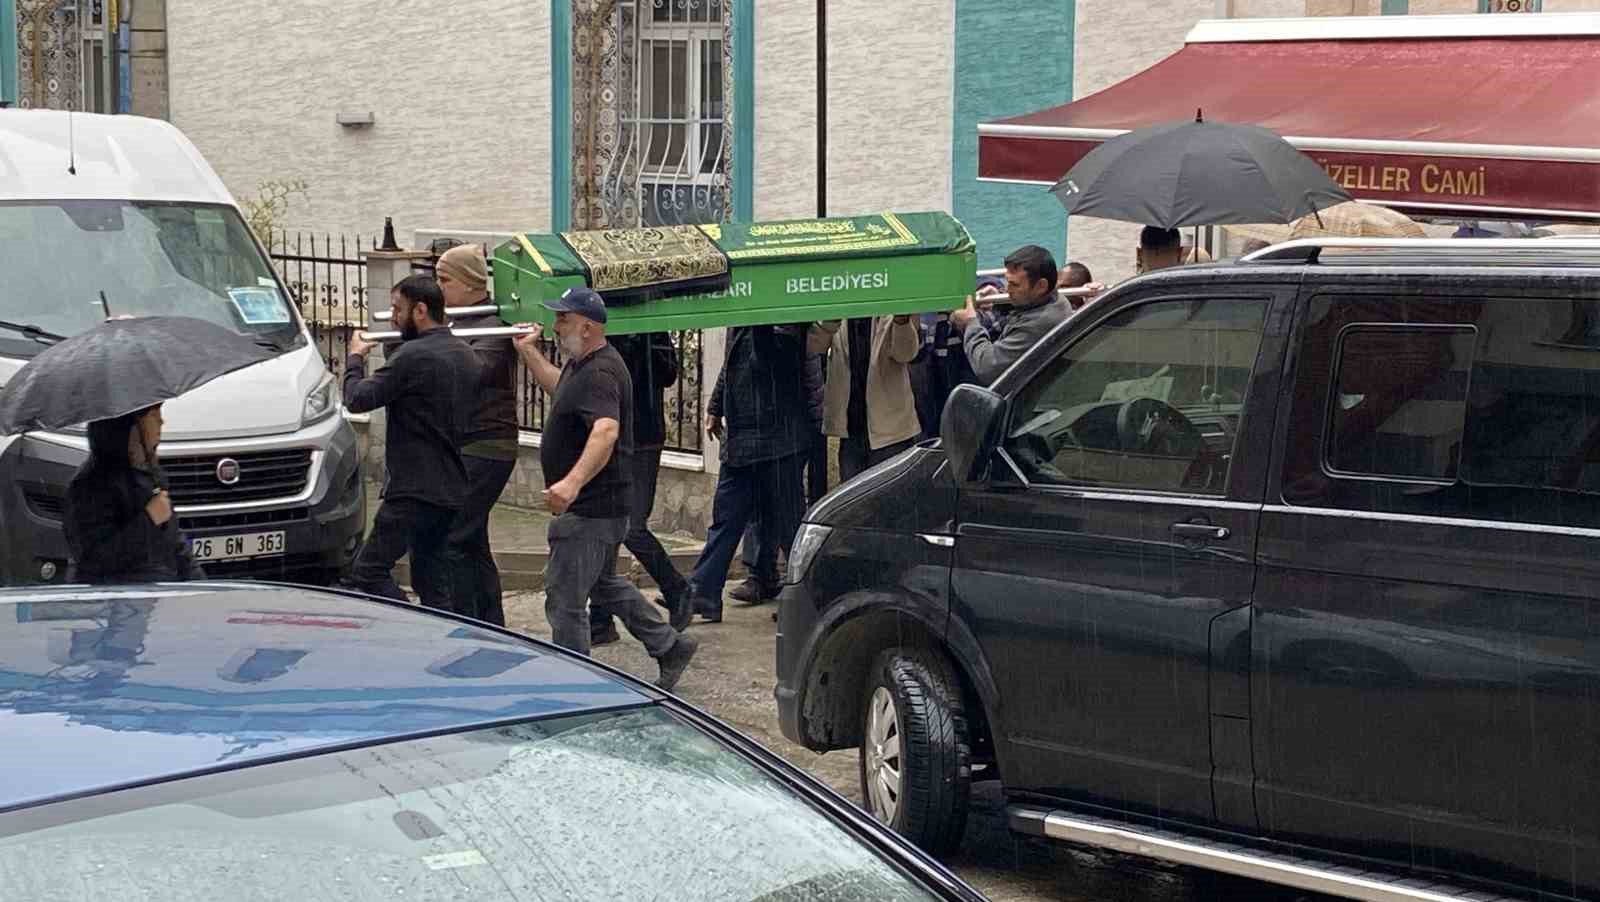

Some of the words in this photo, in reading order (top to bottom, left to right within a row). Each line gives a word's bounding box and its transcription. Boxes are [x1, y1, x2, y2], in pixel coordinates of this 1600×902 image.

[786, 268, 888, 293] BELEDİYESİ
[194, 540, 212, 558] 26
[225, 536, 243, 555] GN
[257, 533, 283, 552] 363
